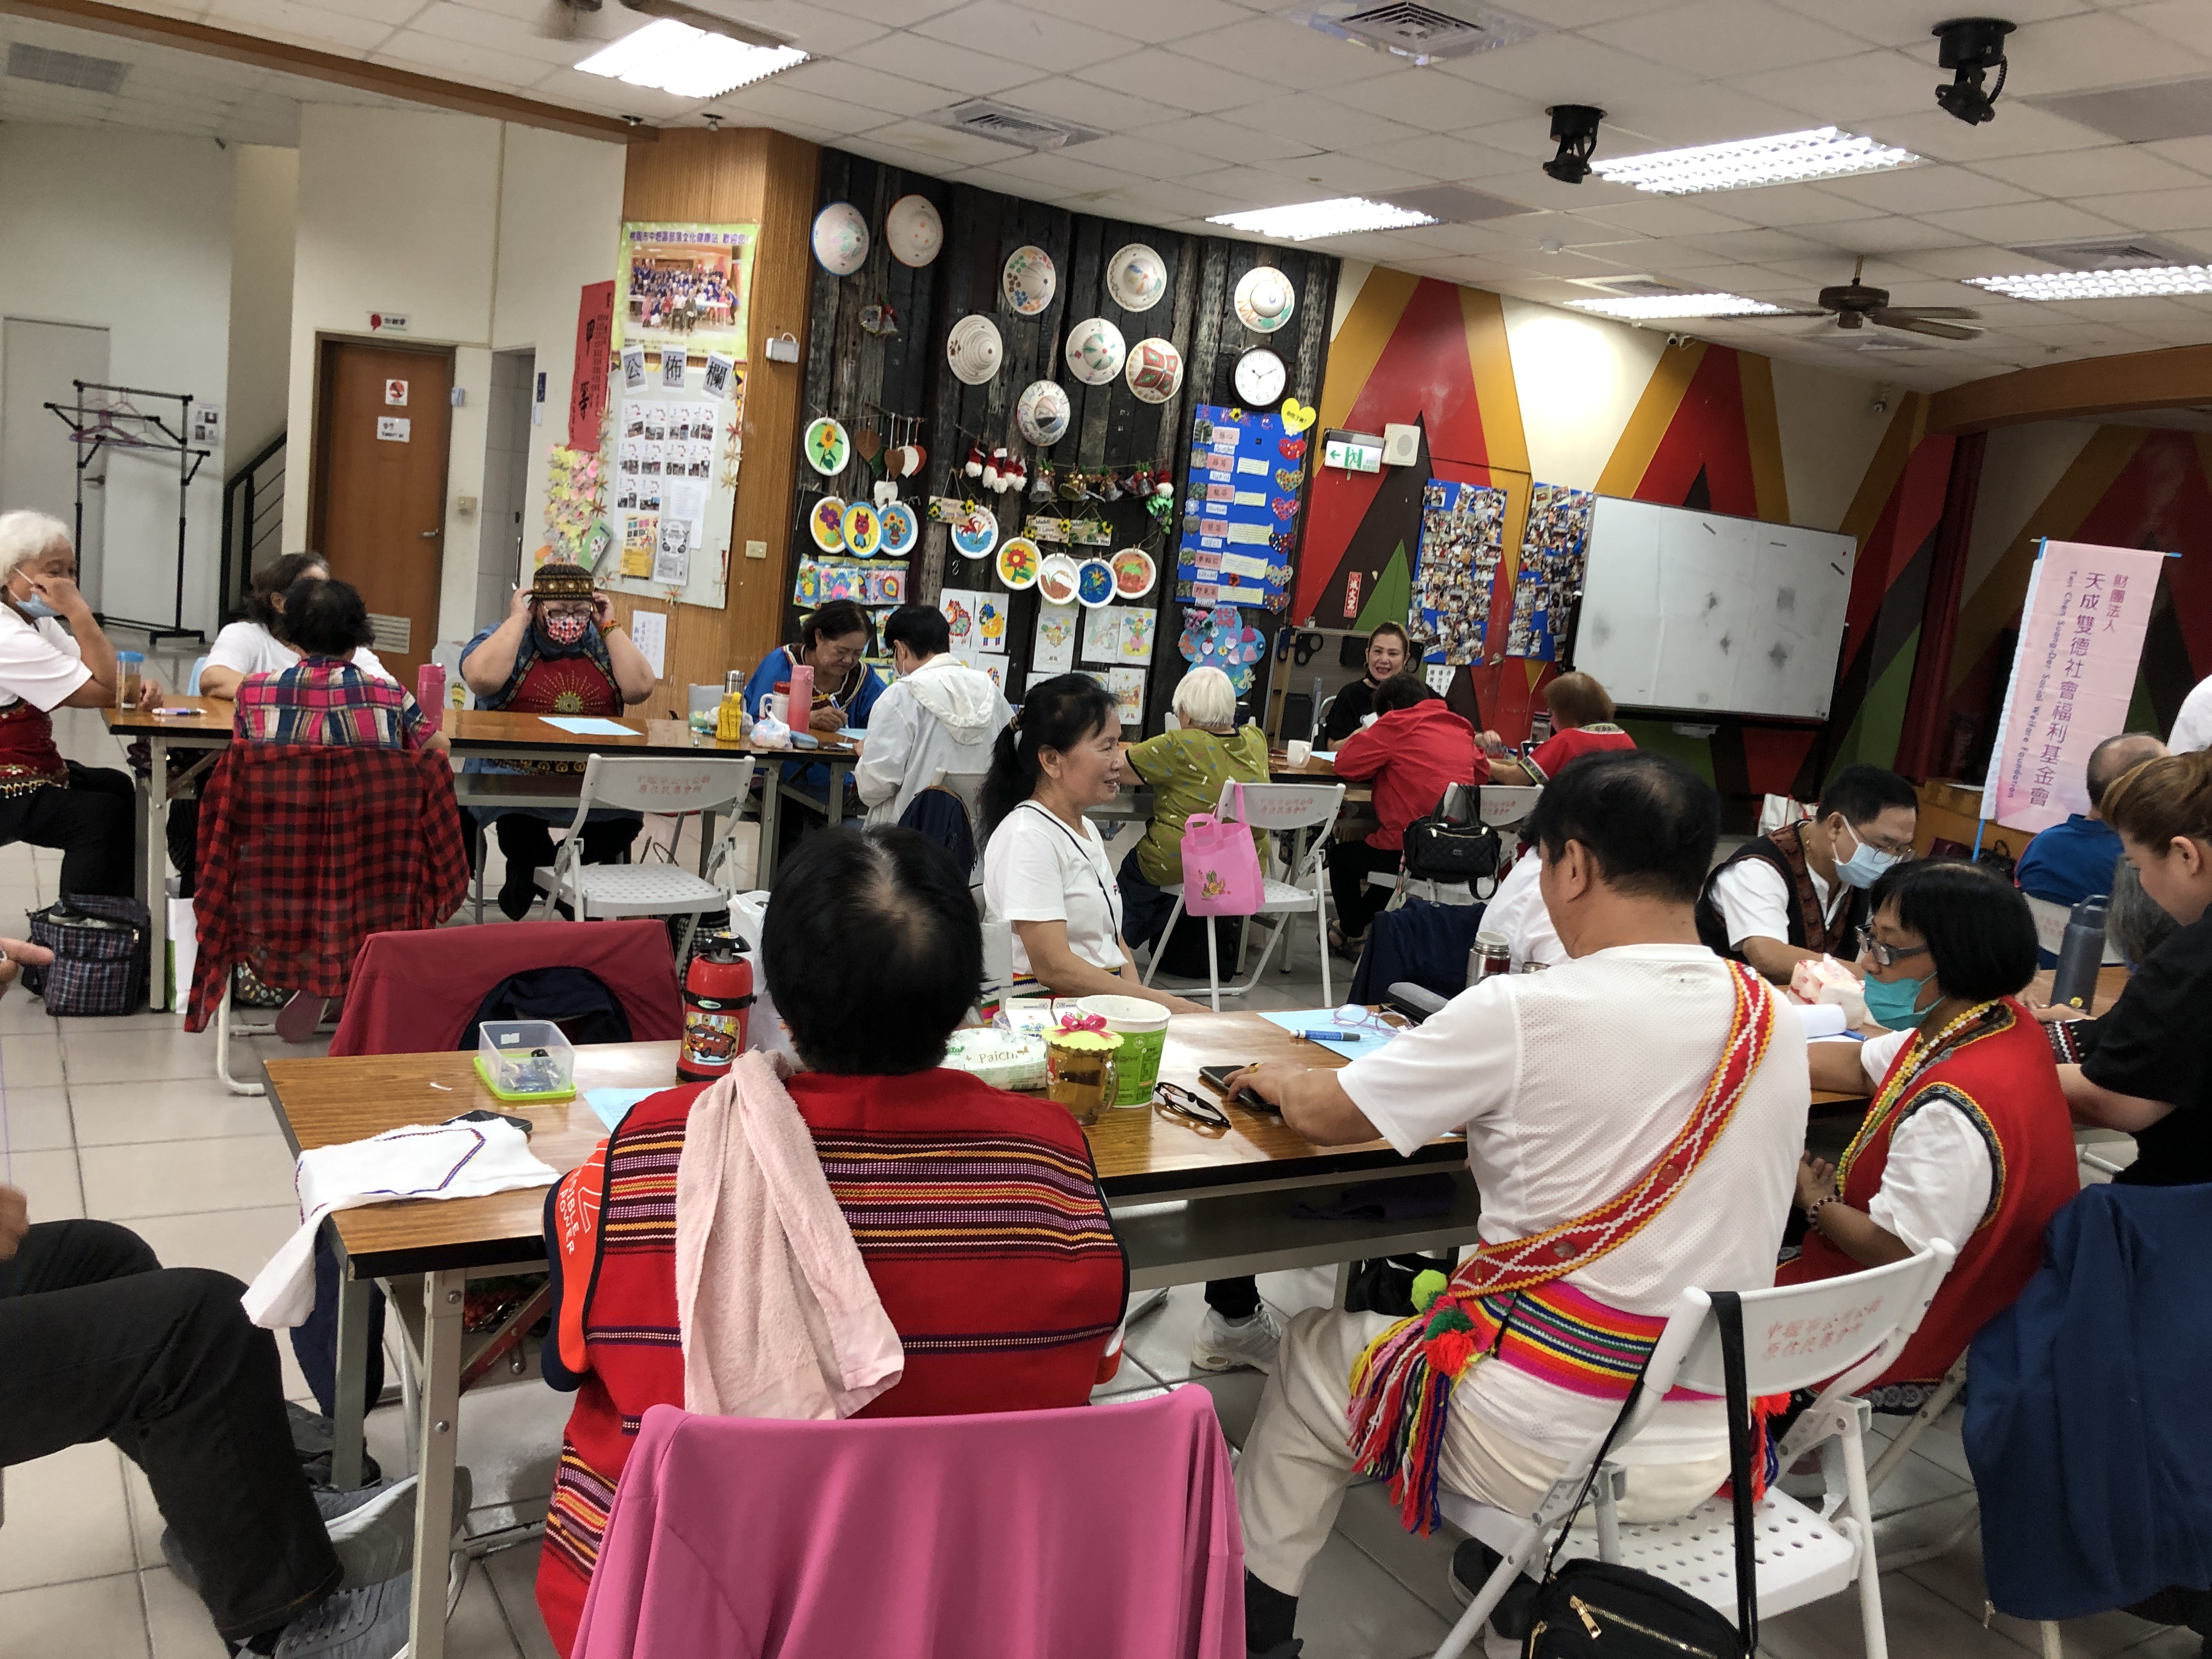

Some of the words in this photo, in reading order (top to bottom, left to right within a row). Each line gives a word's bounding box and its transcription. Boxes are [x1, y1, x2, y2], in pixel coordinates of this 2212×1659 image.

[625, 358, 641, 380] 公
[664, 355, 682, 381] 佈
[706, 361, 727, 390] 欄
[1347, 579, 1359, 611] 滅火器
[2102, 573, 2130, 633] 財團法人
[2030, 572, 2107, 808] 天成雙德社會福利基金會
[2035, 674, 2051, 702] Social
[2022, 706, 2041, 743] Welfare
[2007, 746, 2029, 798] Foundation
[560, 1188, 575, 1255] POWER
